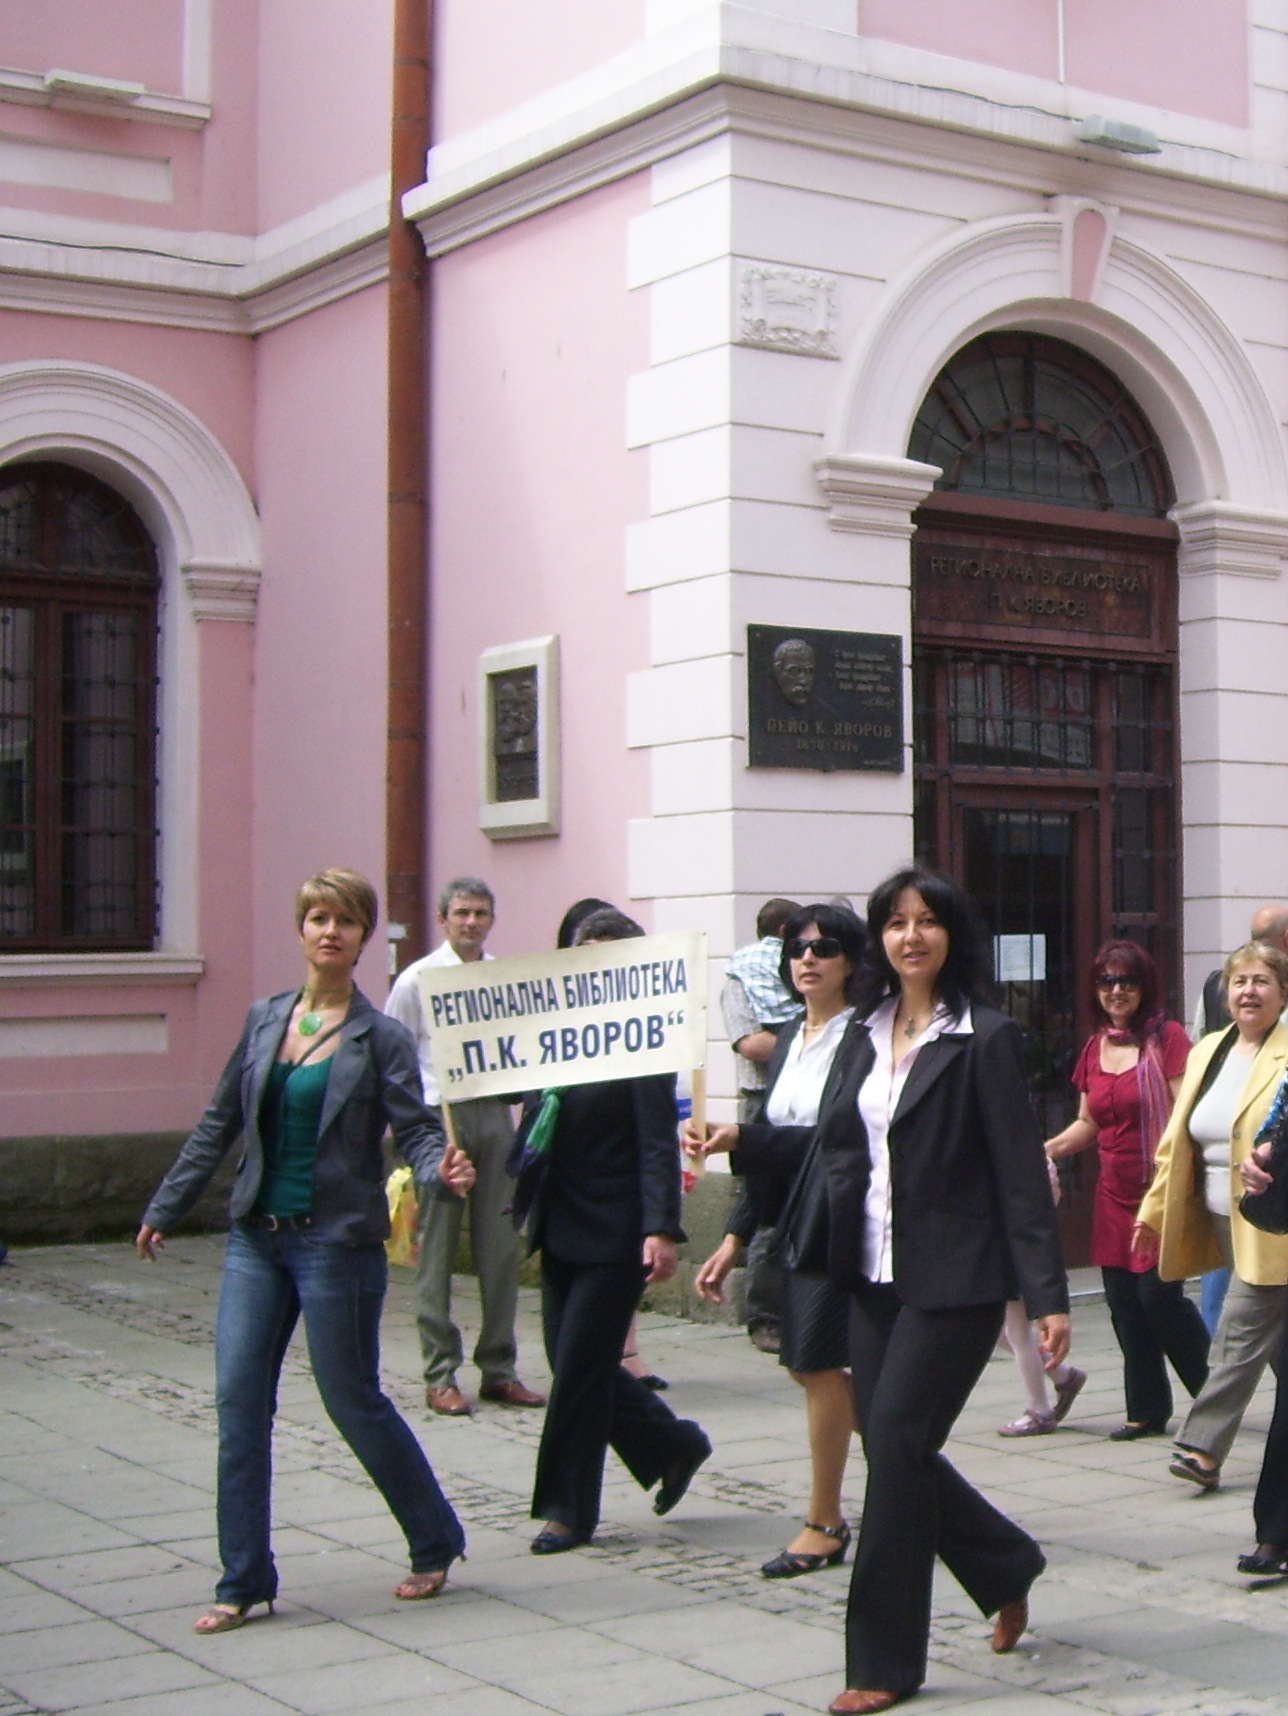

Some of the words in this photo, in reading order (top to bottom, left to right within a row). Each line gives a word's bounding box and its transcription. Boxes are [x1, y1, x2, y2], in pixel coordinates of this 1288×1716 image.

[833, 721, 894, 739] ЯВОРОВ
[430, 978, 560, 1028] РЕГИОНАЛНА
[562, 958, 688, 1010] БИБЛИОТЕКА
